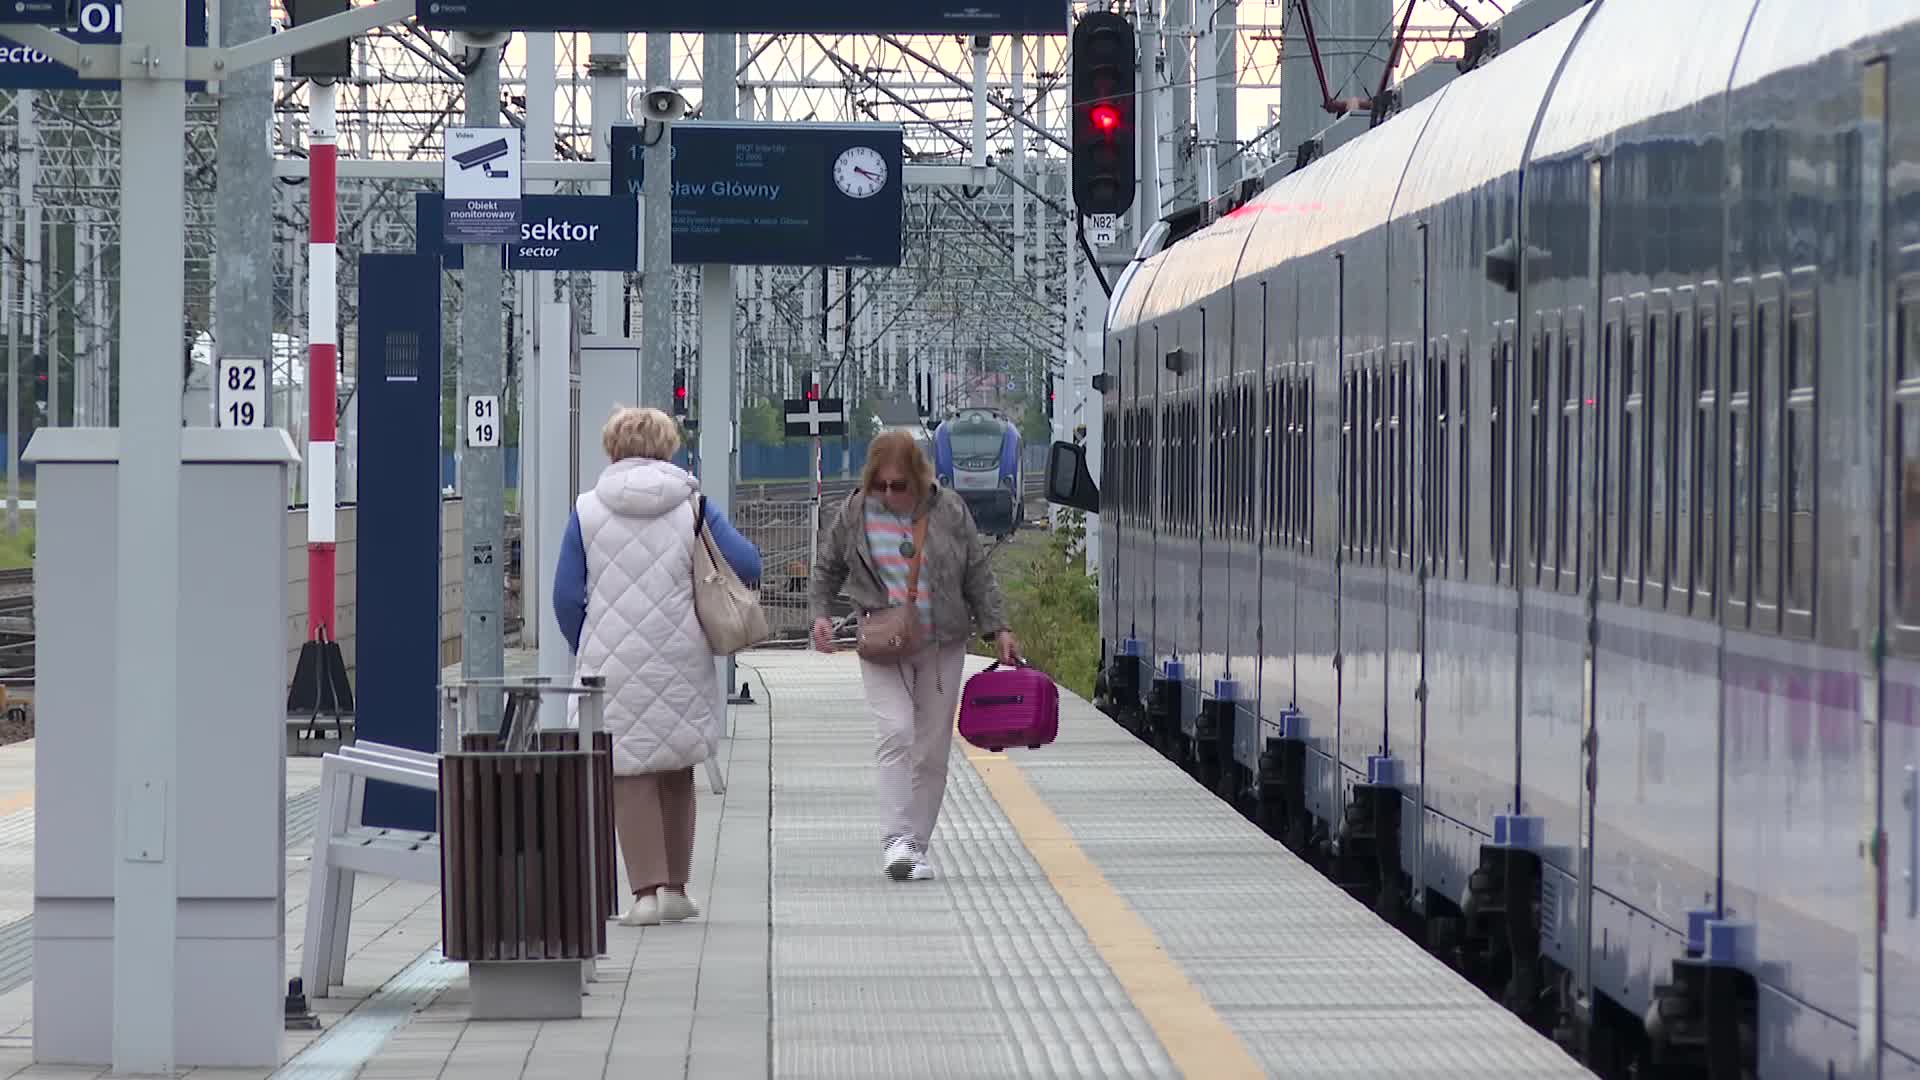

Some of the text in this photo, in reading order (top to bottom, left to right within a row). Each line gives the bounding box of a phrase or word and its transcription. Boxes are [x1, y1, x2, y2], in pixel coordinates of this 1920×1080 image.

[0, 45, 54, 63] ecto
[711, 179, 780, 200] Główny
[467, 201, 498, 210] Obiekt
[450, 210, 516, 221] monitorowany
[521, 217, 599, 241] sektor
[519, 246, 560, 257] sector
[228, 366, 256, 391] 82
[229, 401, 254, 427] 19
[475, 400, 492, 417] 81
[475, 424, 493, 442] 19
